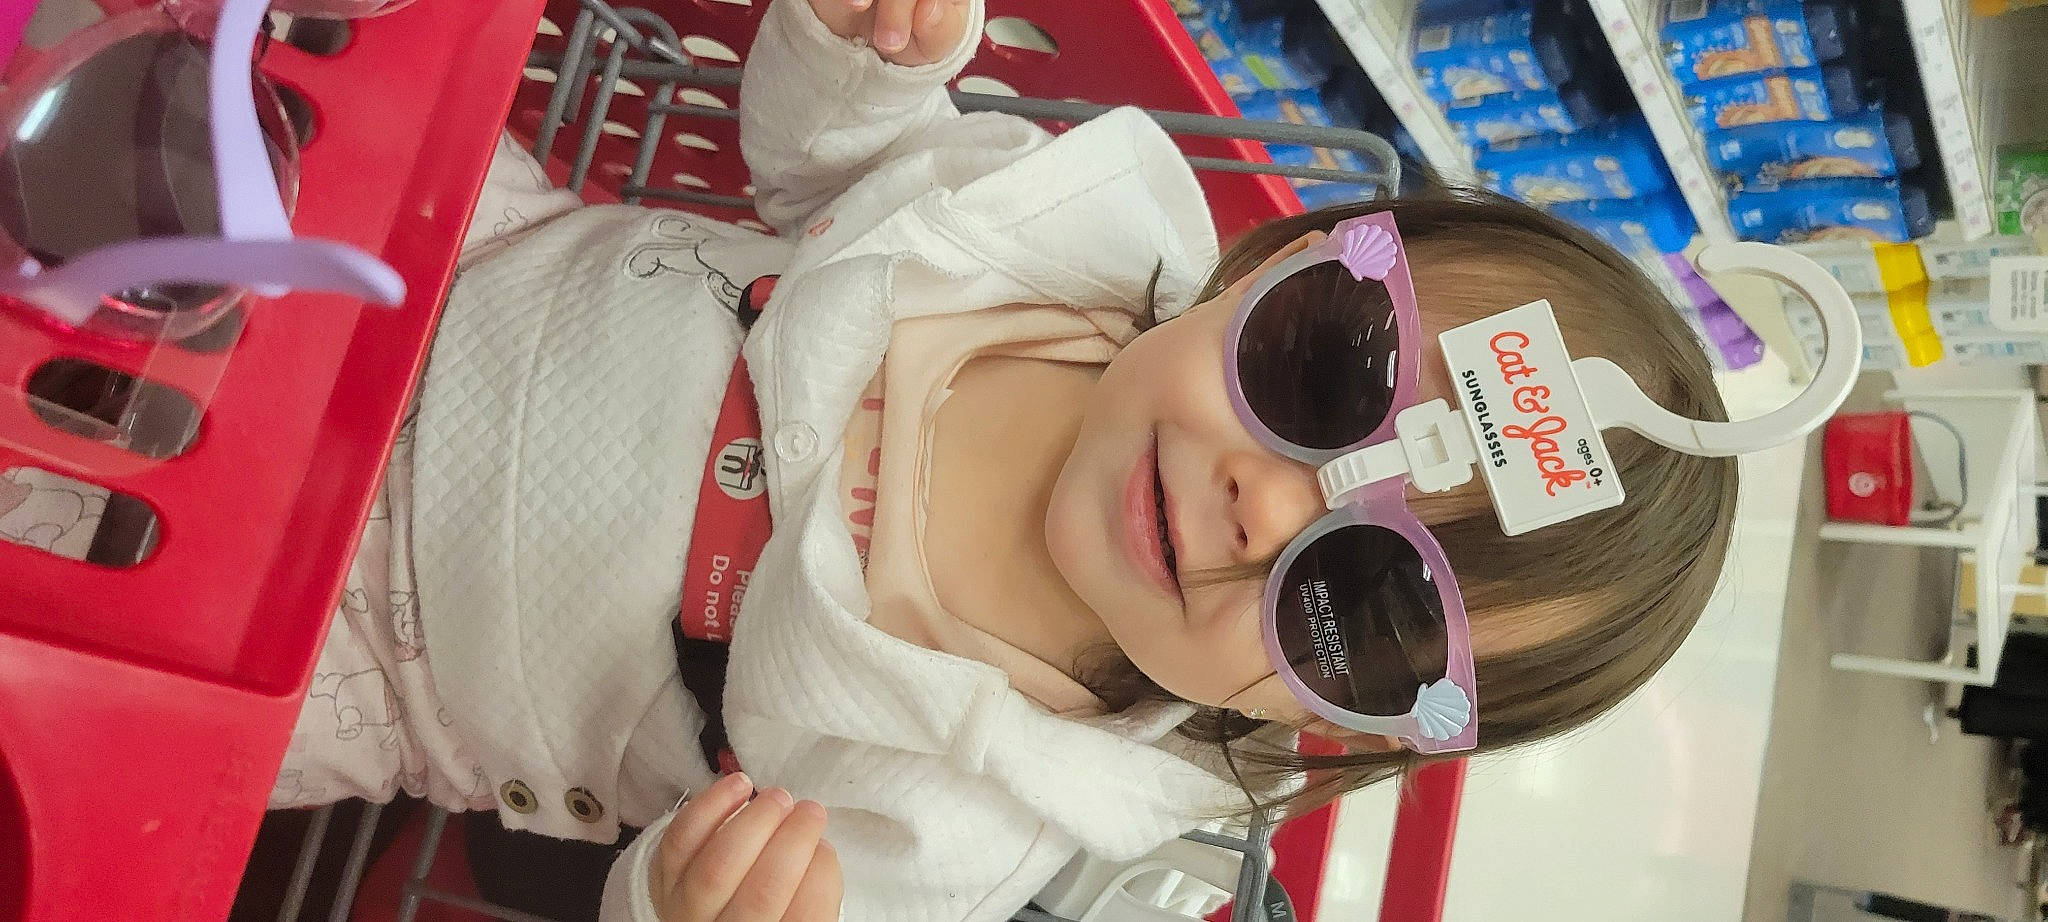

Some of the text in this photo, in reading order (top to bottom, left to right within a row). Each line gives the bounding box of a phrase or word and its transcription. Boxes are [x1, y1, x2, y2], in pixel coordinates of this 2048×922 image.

[1461, 369, 1508, 469] SUNGLASSES
[1489, 331, 1588, 497] Cat & Jack
[1577, 438, 1604, 487] ages 0+
[703, 591, 722, 628] not
[709, 554, 731, 586] Do
[1299, 583, 1332, 679] UV400 PROTECTION
[1313, 580, 1350, 676] IMPACT RESISTANT
